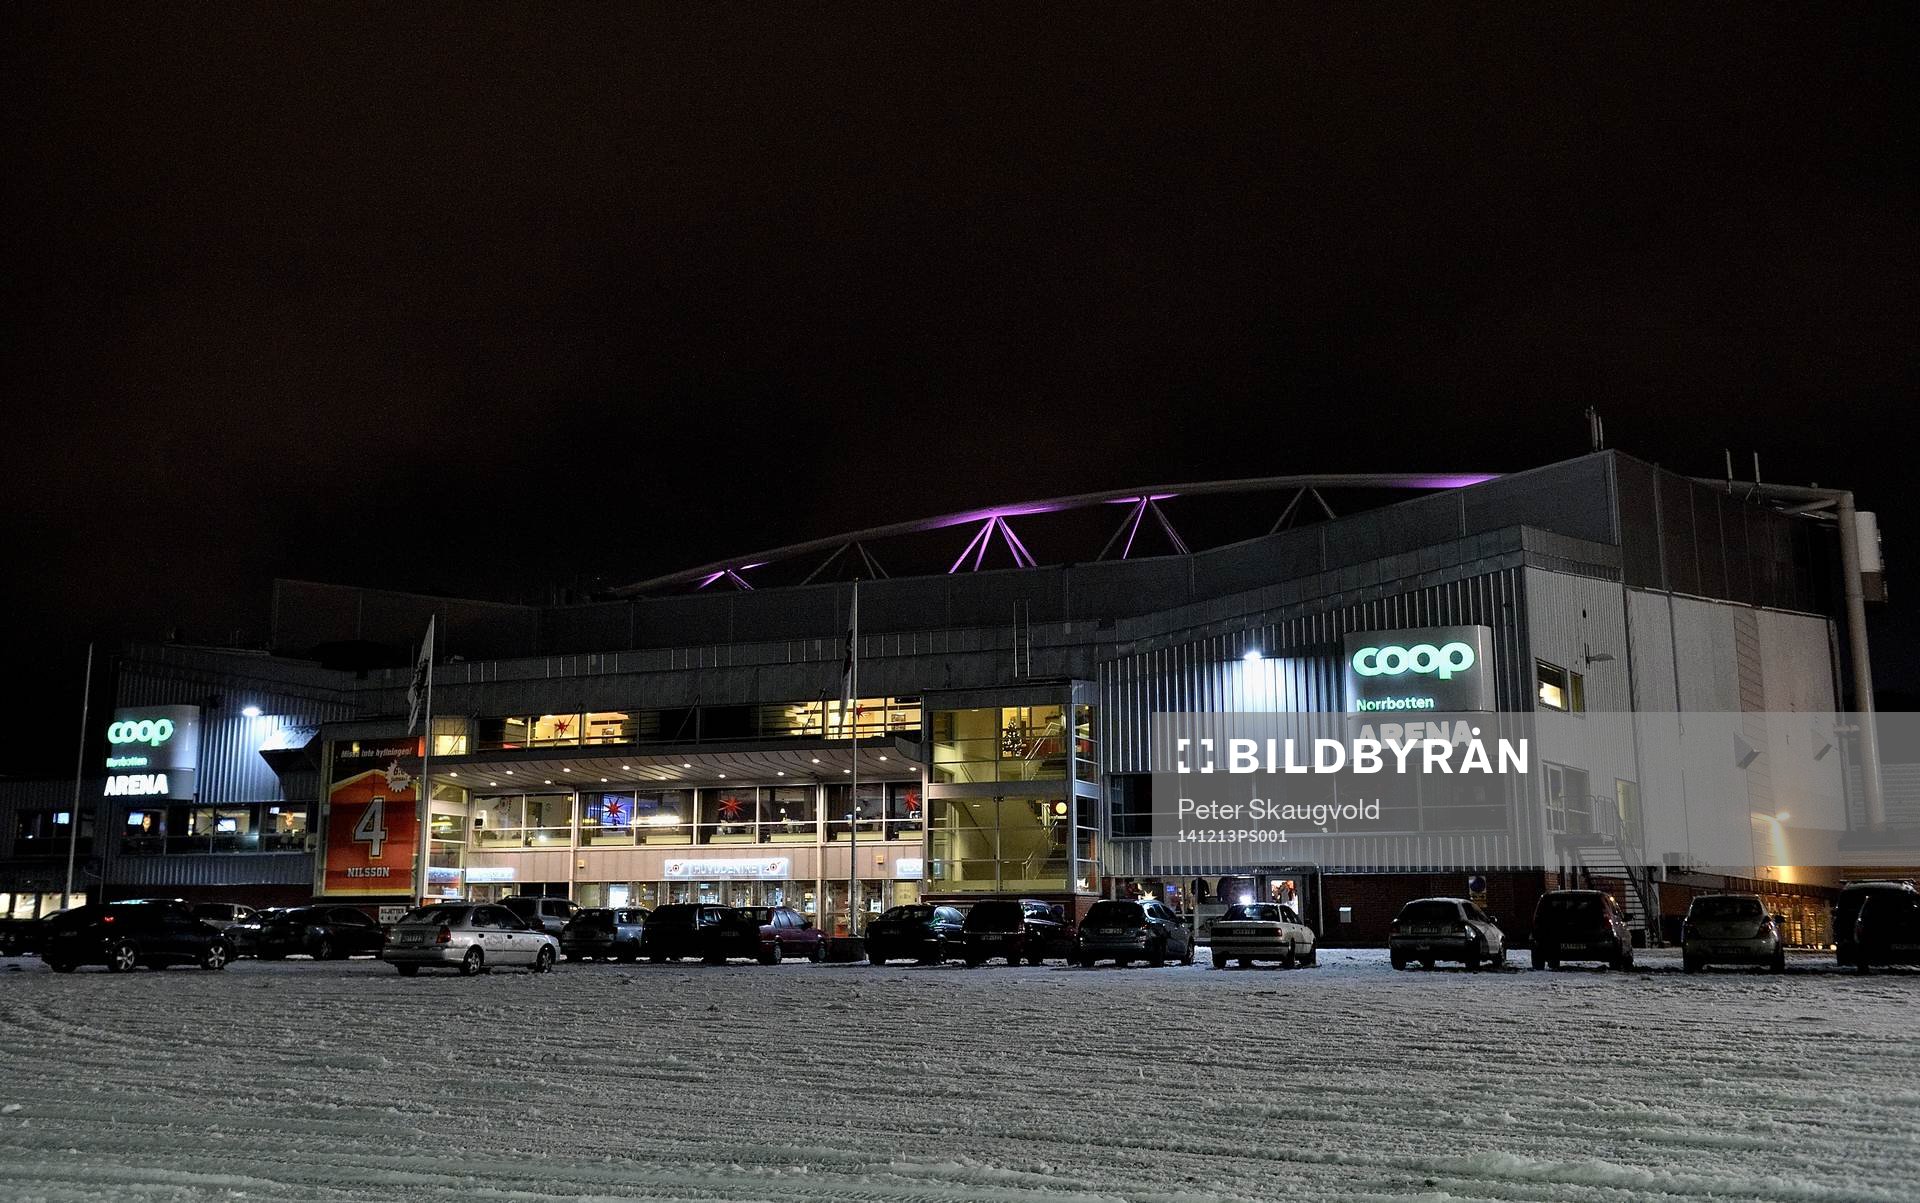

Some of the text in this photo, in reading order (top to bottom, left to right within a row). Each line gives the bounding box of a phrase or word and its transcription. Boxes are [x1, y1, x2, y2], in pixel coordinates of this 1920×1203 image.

[1352, 642, 1475, 680] coop
[1356, 697, 1435, 712] Norrbotten
[107, 718, 174, 747] coop
[103, 774, 169, 797] ARENA
[352, 795, 388, 860] 4
[347, 867, 390, 878] NILSSON
